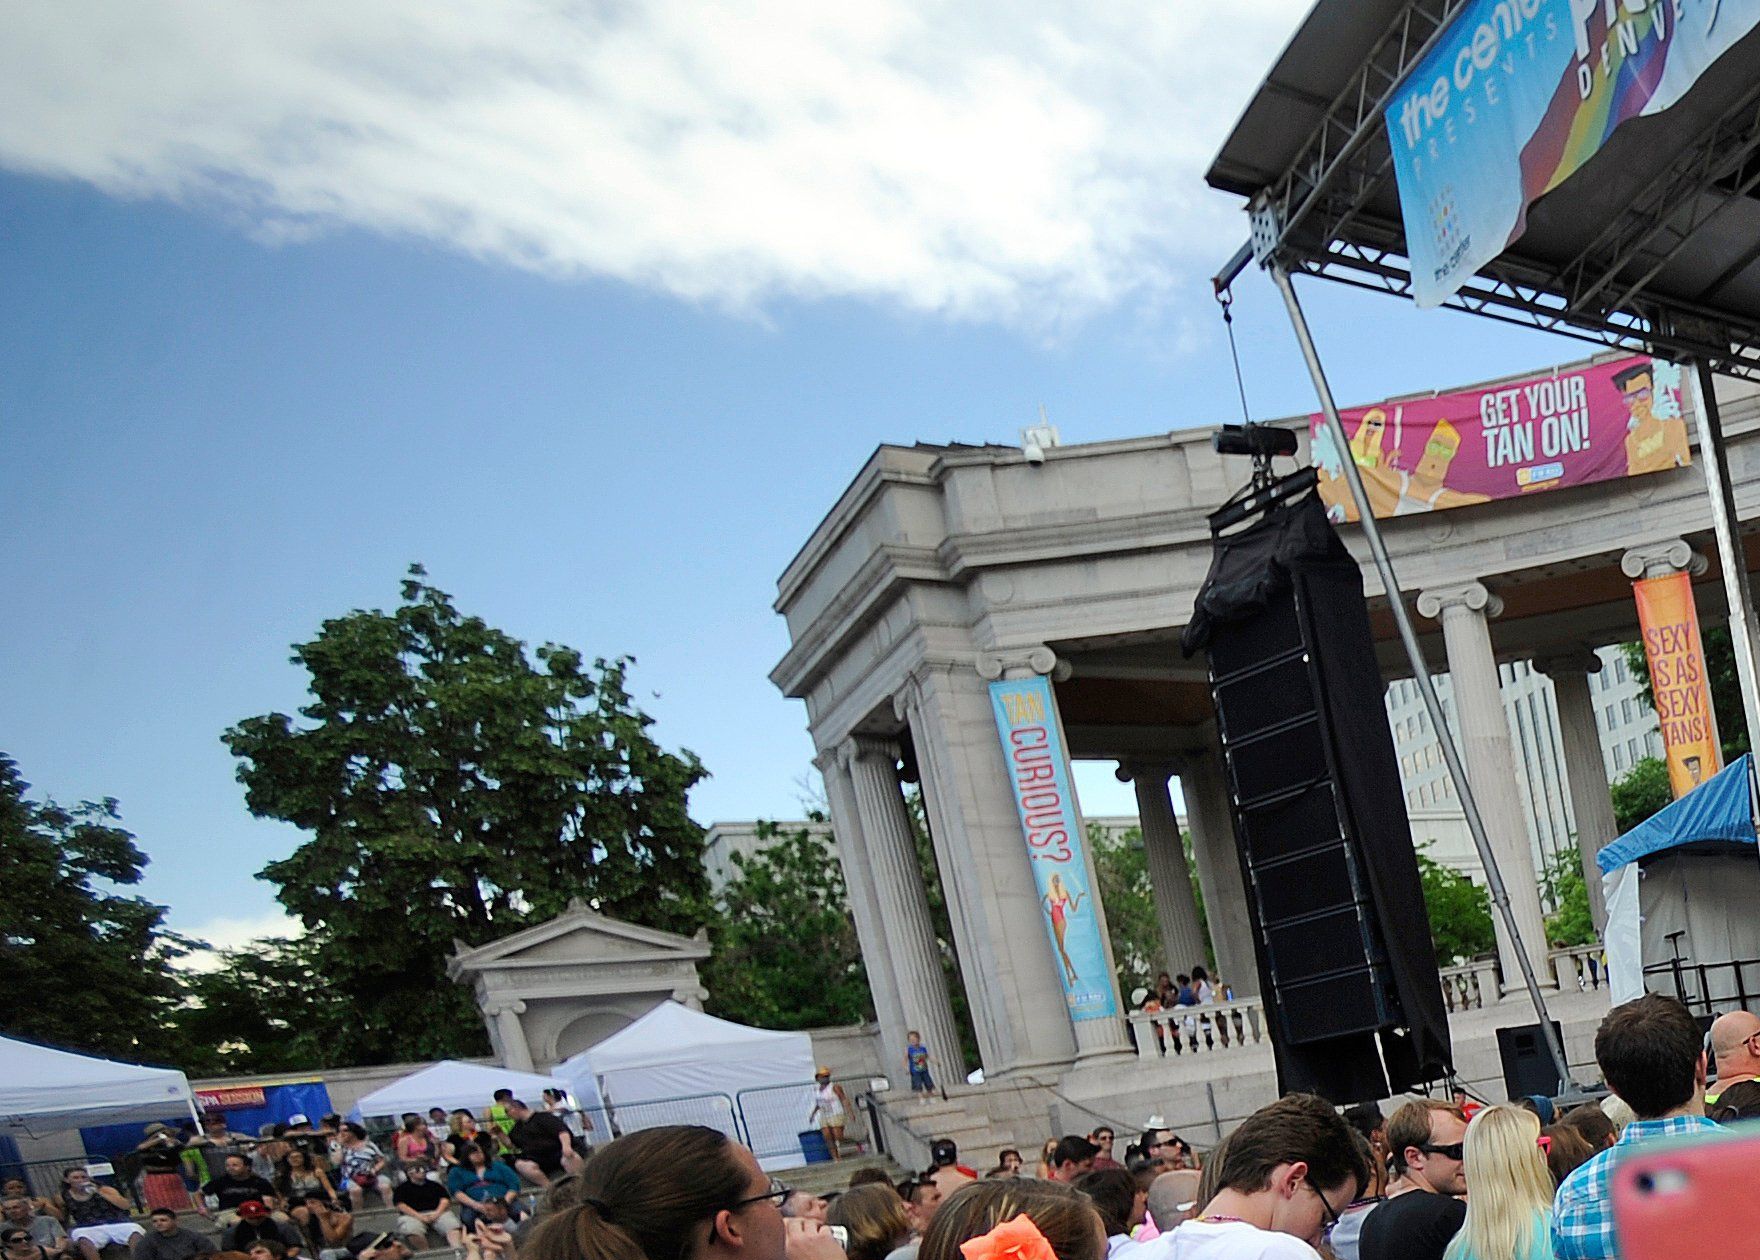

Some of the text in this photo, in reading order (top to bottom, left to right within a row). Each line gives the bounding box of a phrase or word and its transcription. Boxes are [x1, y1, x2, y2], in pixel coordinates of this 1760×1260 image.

[1400, 75, 1449, 150] the
[1453, 0, 1546, 91] cente
[1480, 374, 1587, 429] GET YOUR
[1481, 407, 1592, 468] TAN ON!
[1646, 621, 1691, 657] SEXY
[1652, 652, 1698, 689] IS AS
[1002, 688, 1046, 726] TAN
[1656, 684, 1702, 719] SEXY
[1662, 715, 1710, 748] TANS!
[1010, 727, 1072, 863] CURIOUS?
